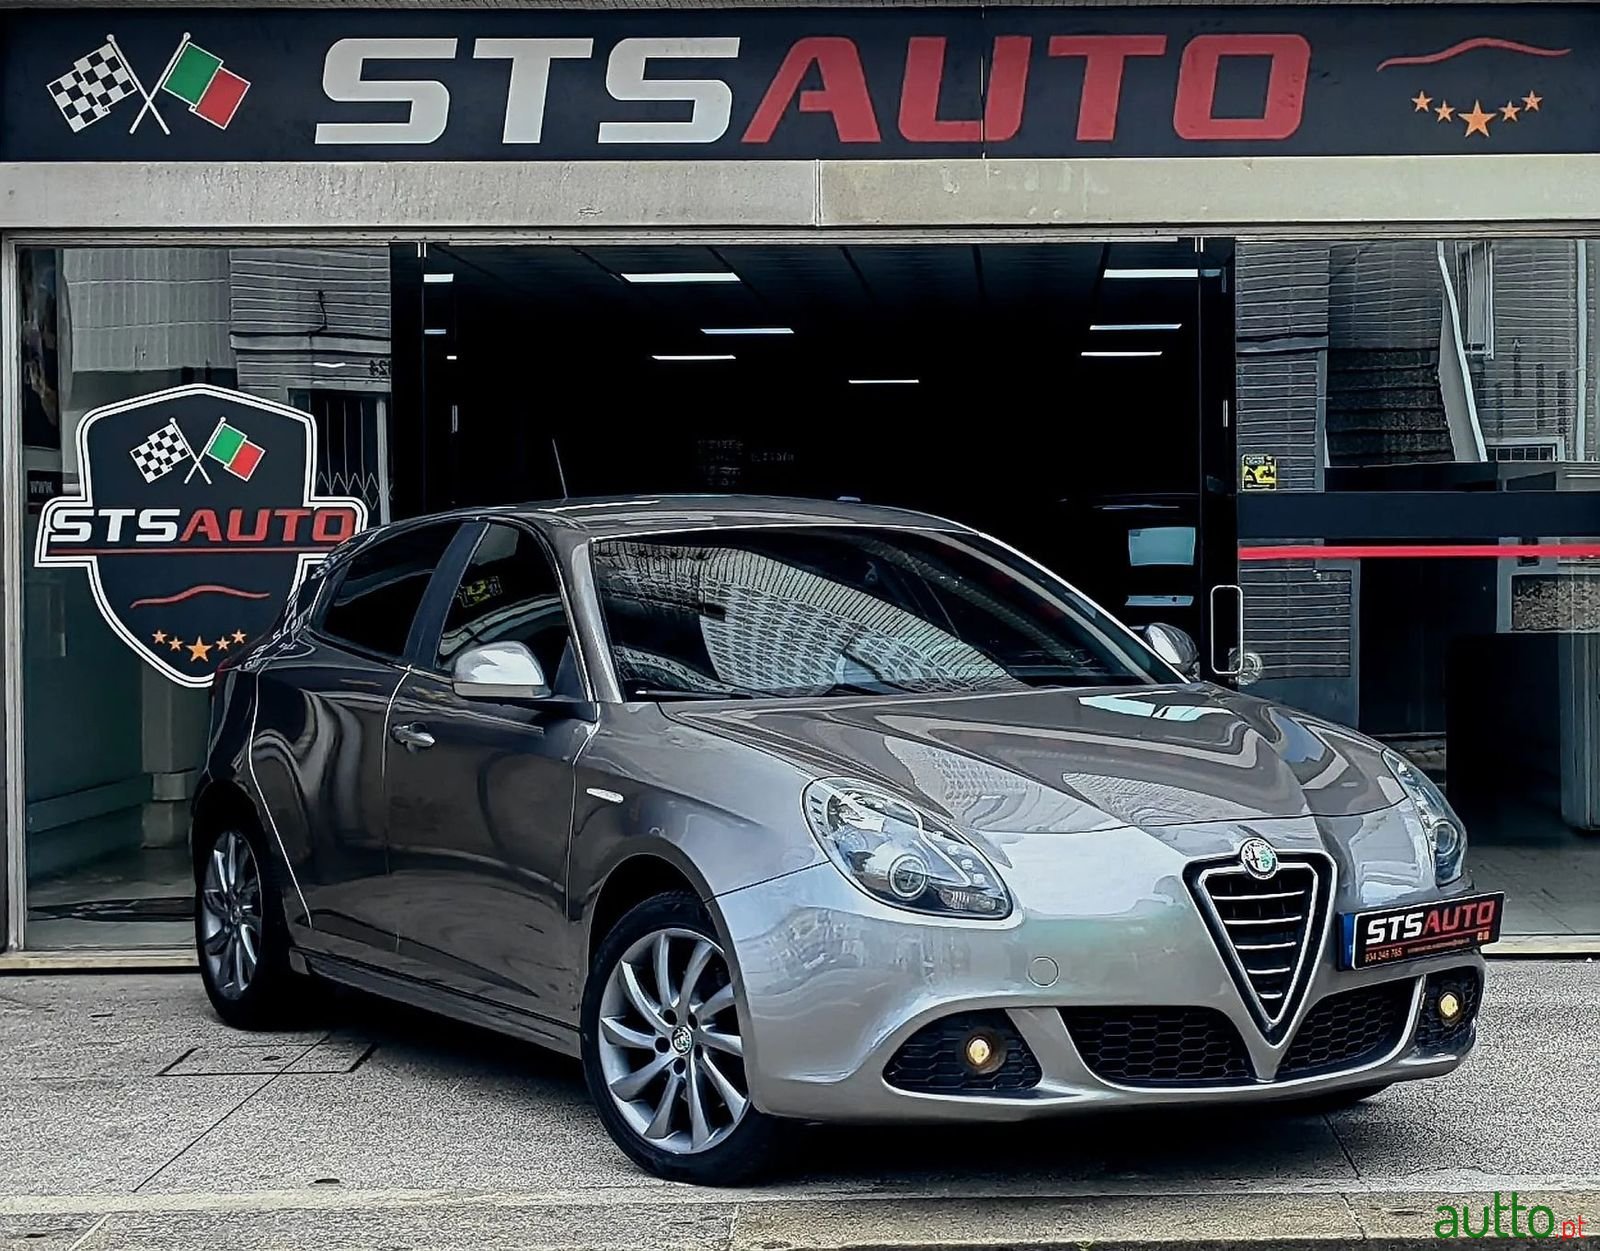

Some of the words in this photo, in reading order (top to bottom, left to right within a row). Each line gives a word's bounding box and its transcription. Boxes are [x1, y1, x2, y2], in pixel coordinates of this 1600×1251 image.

[314, 34, 1311, 144] STSAUTO
[50, 508, 356, 542] STSAUTO
[1366, 901, 1495, 945] STSAUTO
